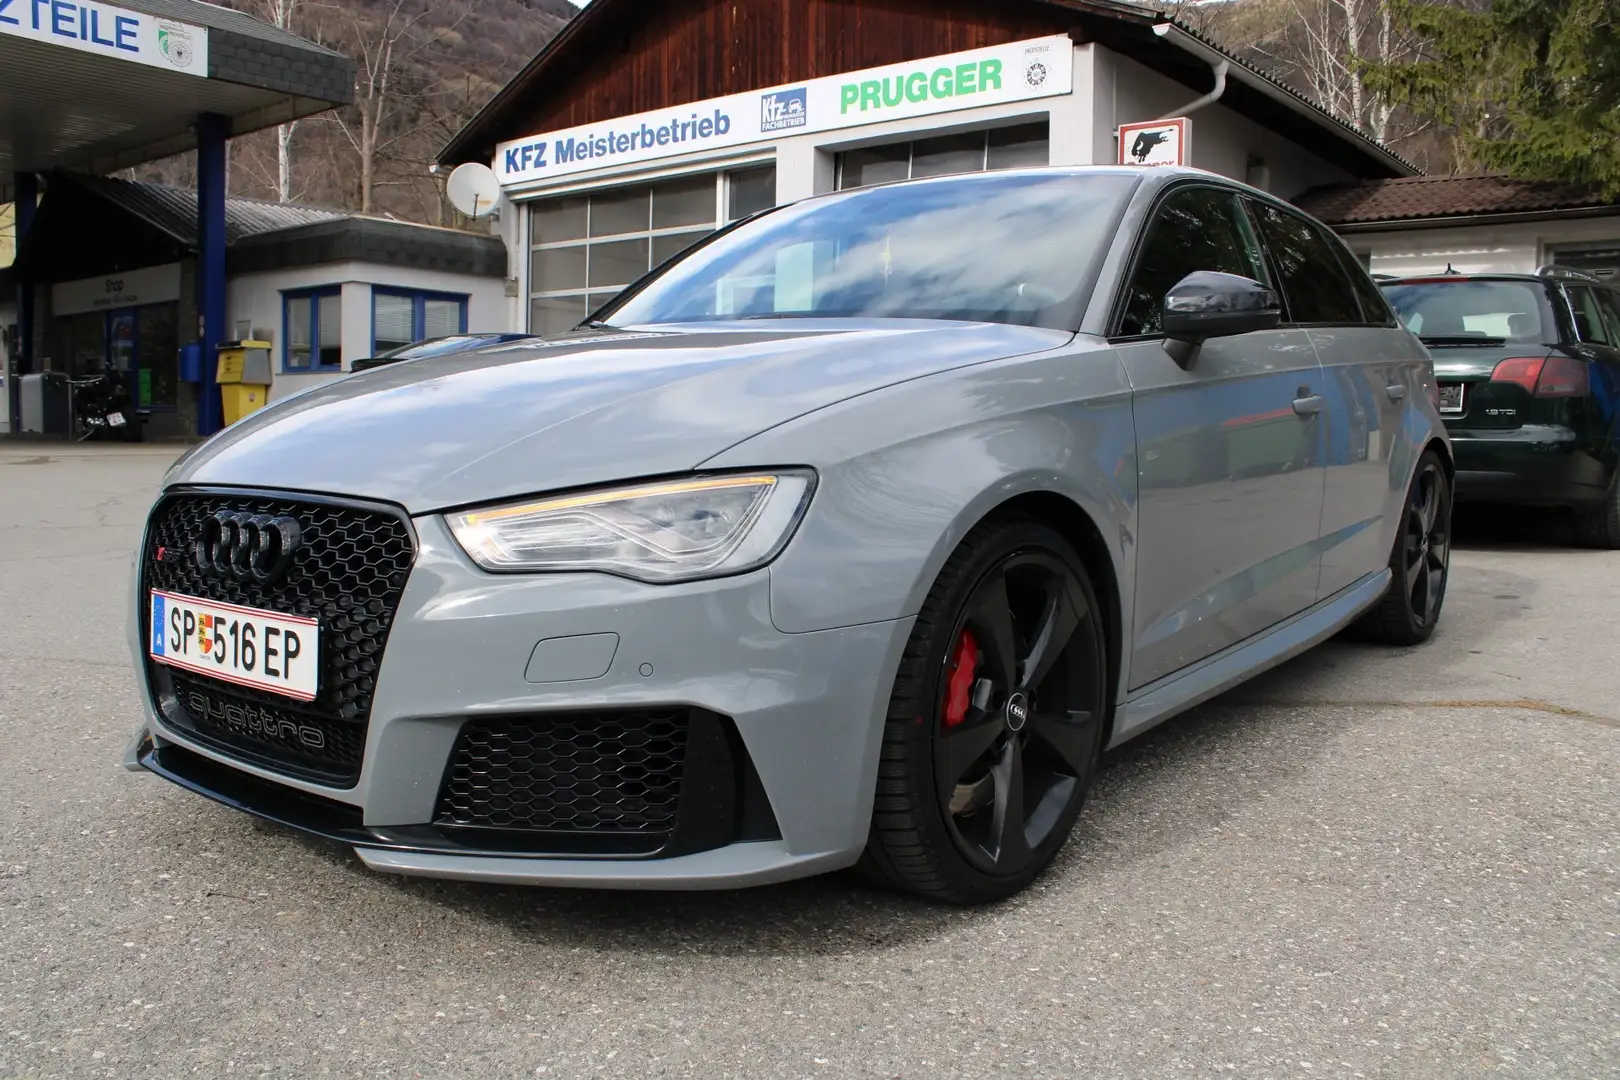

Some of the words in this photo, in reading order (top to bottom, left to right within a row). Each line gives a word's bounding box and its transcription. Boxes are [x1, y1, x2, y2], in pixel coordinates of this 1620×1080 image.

[840, 58, 1003, 114] PRUGGER
[762, 94, 786, 123] Kfz
[762, 116, 805, 131] FACHBETRIEB
[505, 142, 547, 174] KFZ
[555, 109, 731, 164] Meisterbetrieb
[105, 279, 124, 294] Shop
[156, 634, 163, 647] A
[170, 606, 196, 655] SP
[213, 616, 256, 672] 516
[264, 626, 302, 680] EP
[189, 691, 325, 748] quattro
